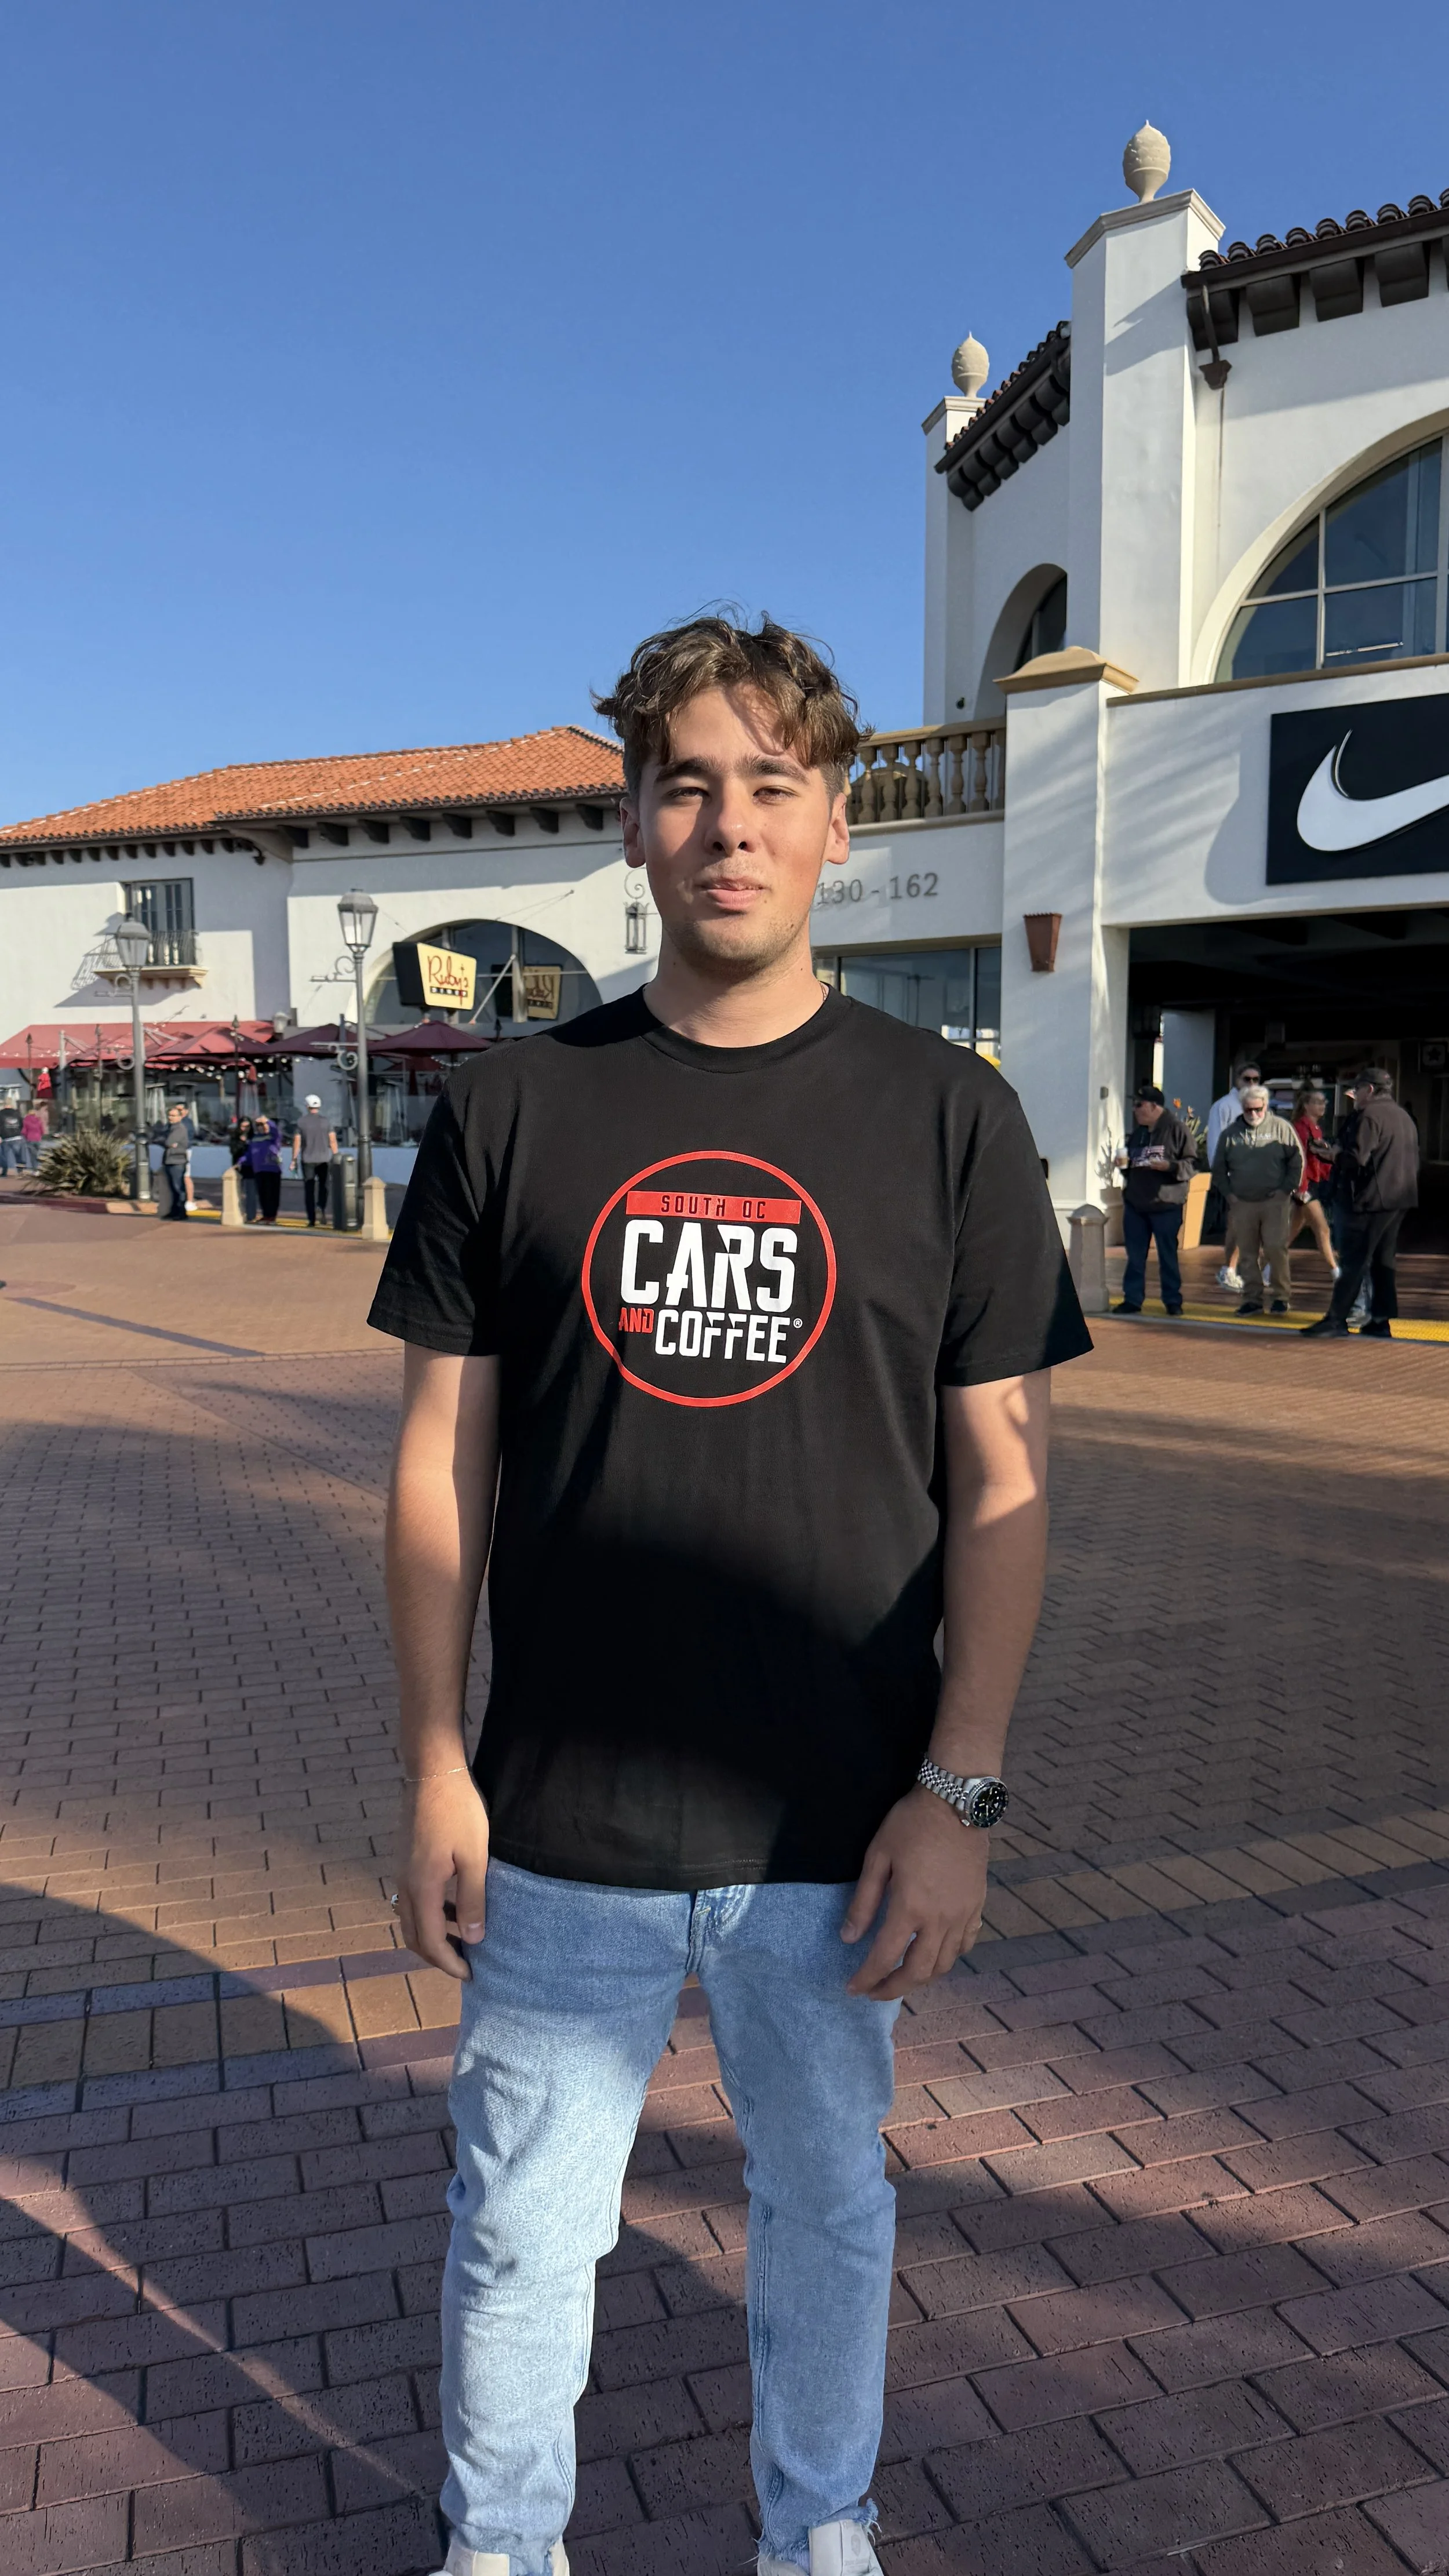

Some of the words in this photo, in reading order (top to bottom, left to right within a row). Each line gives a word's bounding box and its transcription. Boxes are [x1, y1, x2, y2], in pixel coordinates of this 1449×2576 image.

[427, 955, 468, 1006] Ruby's
[661, 1195, 726, 1217] SOUTH
[742, 1200, 766, 1219] OC
[621, 1219, 798, 1313] CARS
[618, 1307, 654, 1333] AND
